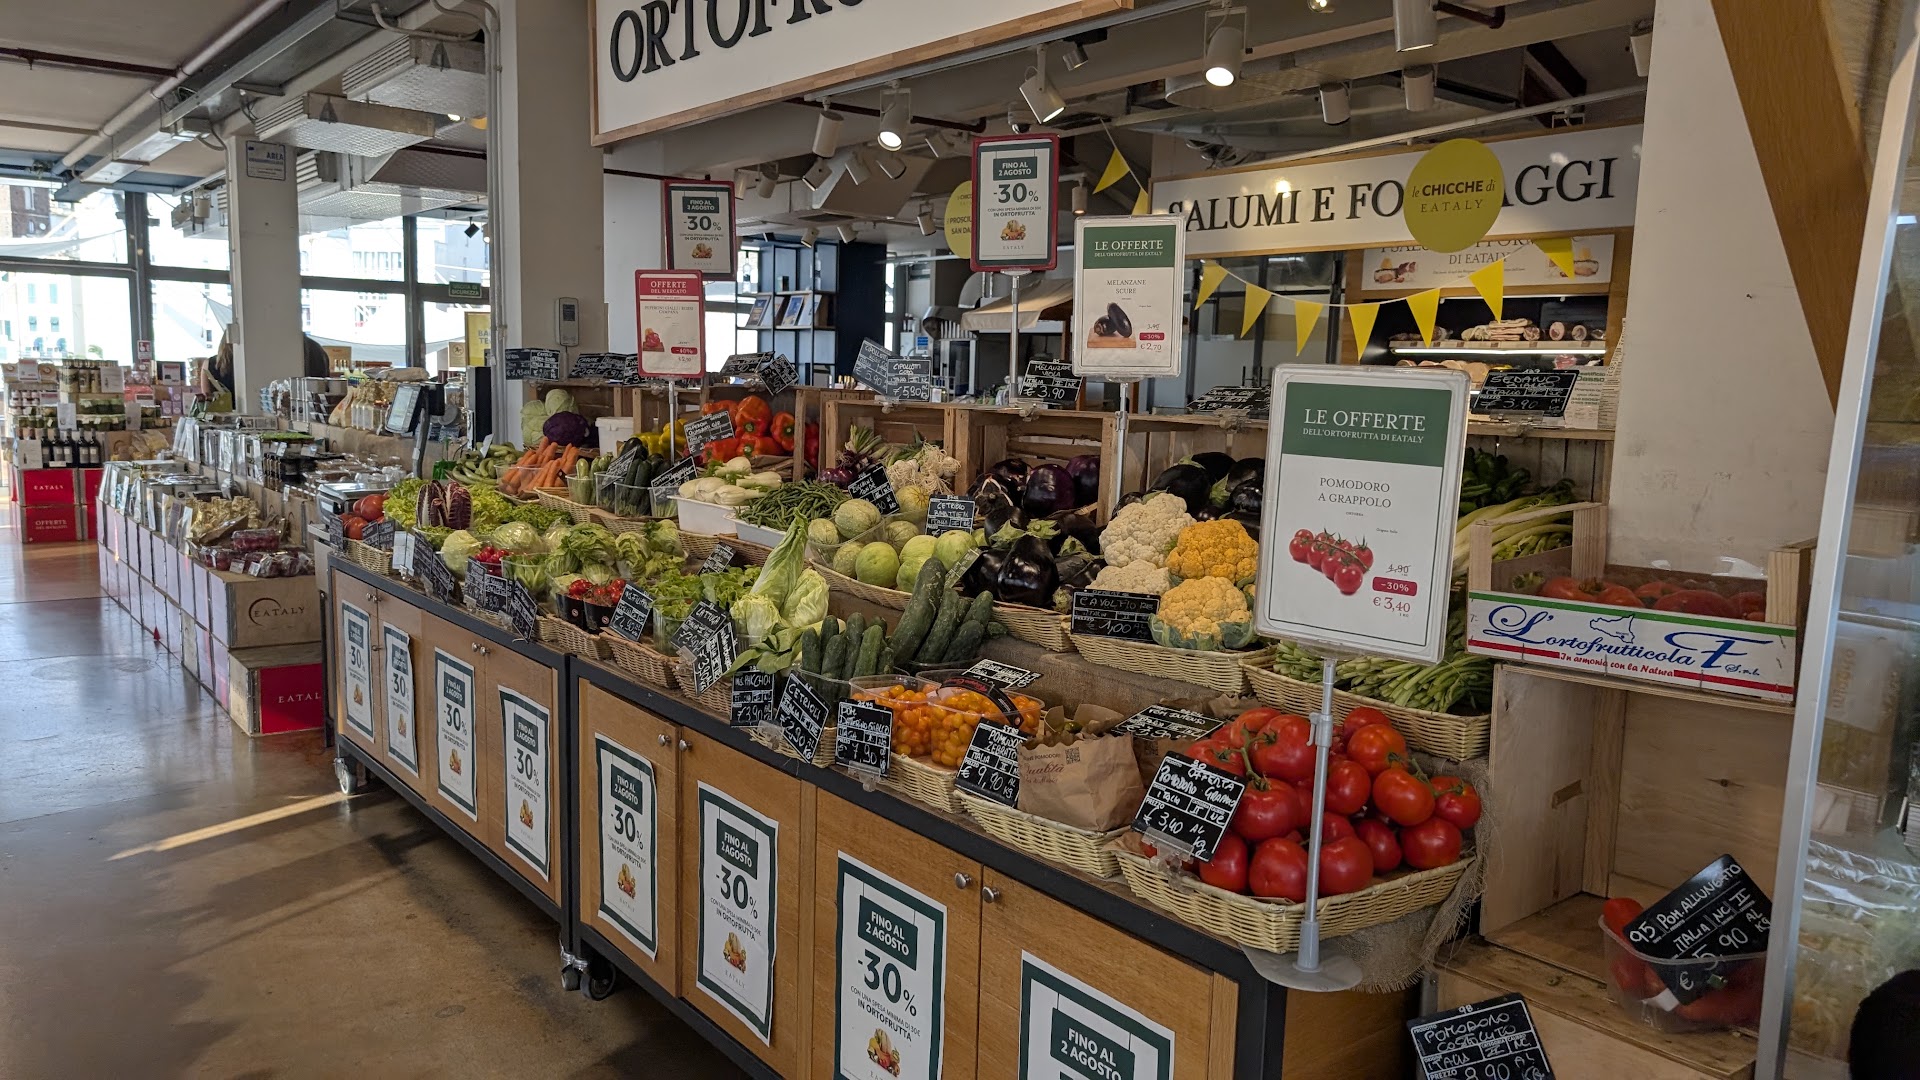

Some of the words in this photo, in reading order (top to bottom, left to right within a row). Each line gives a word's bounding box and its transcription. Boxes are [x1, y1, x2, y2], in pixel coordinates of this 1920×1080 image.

[1003, 168, 1032, 176] AGOSTO
[993, 183, 1039, 203] -30%
[1412, 185, 1420, 198] le
[1422, 180, 1484, 197] CHICCHE
[1486, 180, 1496, 192] di
[1310, 187, 1335, 222] E
[1421, 199, 1484, 213] EATALY
[683, 215, 722, 231] -30%
[1094, 241, 1109, 251] LE
[1111, 239, 1164, 250] OFFERTE
[1449, 254, 1463, 265] DI
[650, 281, 687, 289] OFFERTE
[1115, 287, 1137, 295] SCURE
[1490, 374, 1561, 384] SEDANO
[1023, 387, 1036, 397] €
[1037, 385, 1065, 399] 3,90
[1502, 397, 1539, 410] 3,90
[1304, 408, 1327, 424] LE
[1332, 410, 1426, 432] OFFERTE
[1302, 428, 1379, 441] DELL'ORTOFRUTTA
[1391, 435, 1424, 444] EATALY
[1319, 477, 1390, 493] POMODORO
[936, 501, 966, 511] CETRIOLO
[1318, 493, 1326, 502] A
[1328, 494, 1392, 509] GRAPPOLO
[1380, 581, 1410, 593] -30%
[254, 607, 305, 618] EATALY
[1372, 596, 1381, 607] €
[1384, 596, 1411, 613] 3,40
[695, 606, 721, 626] LATTUGA
[1098, 620, 1132, 635] 1,00
[1483, 604, 1696, 666] L'ortofrutticola
[1560, 652, 1572, 661] In
[1573, 655, 1608, 667] armonia
[1610, 662, 1627, 670] con
[1628, 662, 1639, 672] la
[1640, 664, 1674, 677] Natura
[447, 679, 456, 690] FINO
[278, 692, 321, 704] EATAL
[449, 689, 463, 702] AGOSTO
[788, 683, 822, 721] CETRIOLI
[443, 703, 468, 736] -30%
[518, 722, 528, 736] FINO
[528, 730, 534, 739] AL
[520, 732, 536, 748] AGOSTO
[970, 751, 991, 764] ITALIA
[984, 740, 1018, 762] ZEBRATO
[513, 747, 539, 787] -30%
[616, 775, 629, 788] FINO
[628, 782, 636, 794] AL
[960, 765, 972, 779] €
[977, 765, 1004, 792] 9,90
[1007, 778, 1016, 788] AL
[614, 784, 619, 793] 2
[619, 785, 639, 806] AGOSTO
[1145, 797, 1166, 809] PREZZO
[610, 804, 643, 850] -30%
[1158, 811, 1184, 834] 3,40
[1189, 823, 1205, 834] AL
[724, 831, 741, 849] FINO
[740, 841, 750, 854] AL
[616, 845, 642, 869] ORTOFRUTTA
[721, 841, 726, 852] 2
[726, 843, 753, 868] AGOSTO
[715, 864, 759, 920] -30%
[716, 908, 722, 919] IN
[722, 912, 756, 941] ORTOFRUTTA
[1673, 923, 1711, 954] ITALIA
[1729, 887, 1751, 907] II
[1745, 908, 1763, 922] AL
[870, 910, 892, 933] FINO
[892, 925, 905, 941] AL
[1629, 921, 1655, 943] 95
[865, 922, 872, 934] 2
[872, 925, 910, 957] AGOSTO
[1679, 971, 1694, 990] €
[1718, 927, 1748, 949] 90
[857, 948, 917, 1017] -30%
[850, 985, 861, 997] CON
[861, 991, 872, 1004] UNA
[872, 997, 886, 1013] SPESA
[886, 1007, 904, 1028] MINIMA
[910, 1024, 921, 1038] 30€
[1458, 1004, 1474, 1014] 98
[857, 998, 865, 1010] IN
[866, 1003, 912, 1042] ORTOFRUTTA
[1068, 1028, 1098, 1055] FINO
[1099, 1047, 1117, 1067] AL
[1060, 1040, 1068, 1054] 2
[1069, 1048, 1122, 1080] AGOSTO
